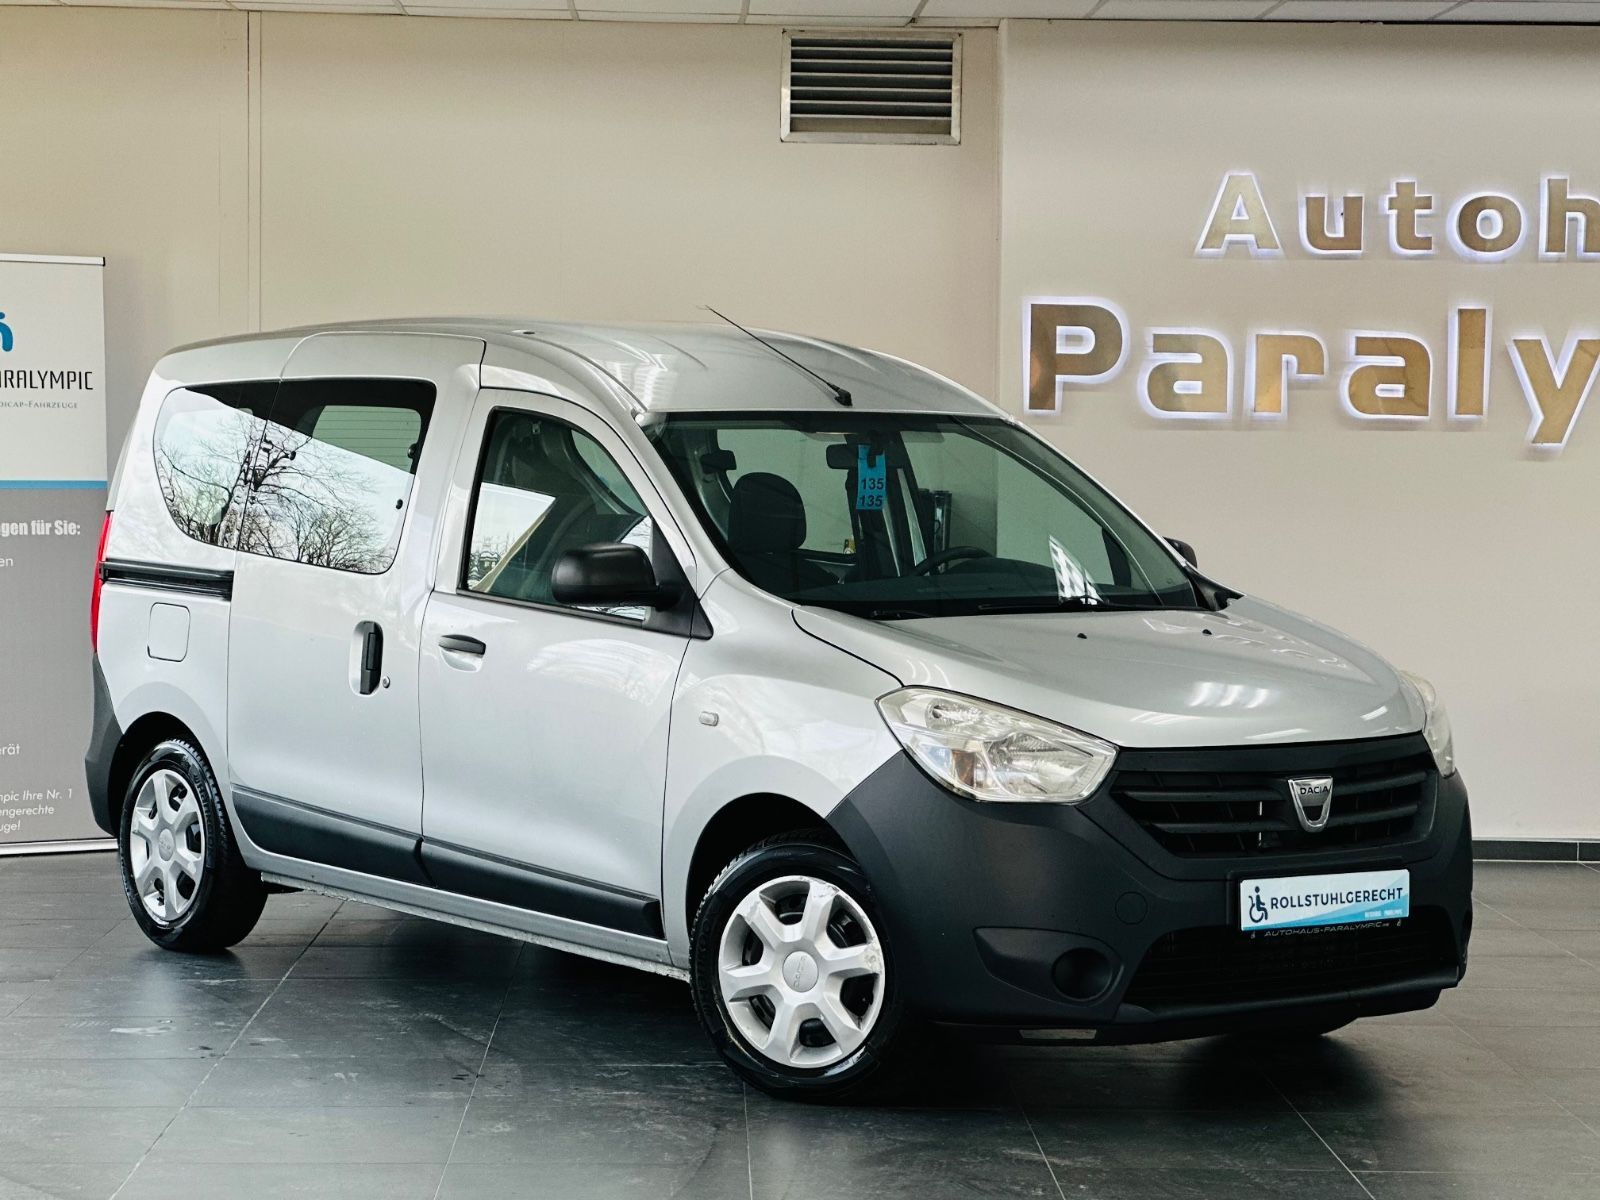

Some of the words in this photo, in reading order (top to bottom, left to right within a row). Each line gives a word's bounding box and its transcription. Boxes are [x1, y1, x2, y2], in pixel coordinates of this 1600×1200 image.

[1197, 172, 1600, 255] Autoh
[0, 369, 94, 390] RALYMPIC
[1024, 300, 1600, 447] Paraly
[861, 478, 884, 490] 135
[860, 495, 883, 507] 135
[1, 522, 28, 537] gen
[31, 519, 51, 536] für
[54, 520, 81, 536] Sie:
[0, 743, 20, 755] rät
[22, 789, 43, 801] Ihre
[46, 788, 62, 800] Nr.
[67, 788, 73, 799] 1
[1300, 785, 1329, 795] DACIA
[1270, 887, 1403, 909] ROLLSTUHLGERECHT
